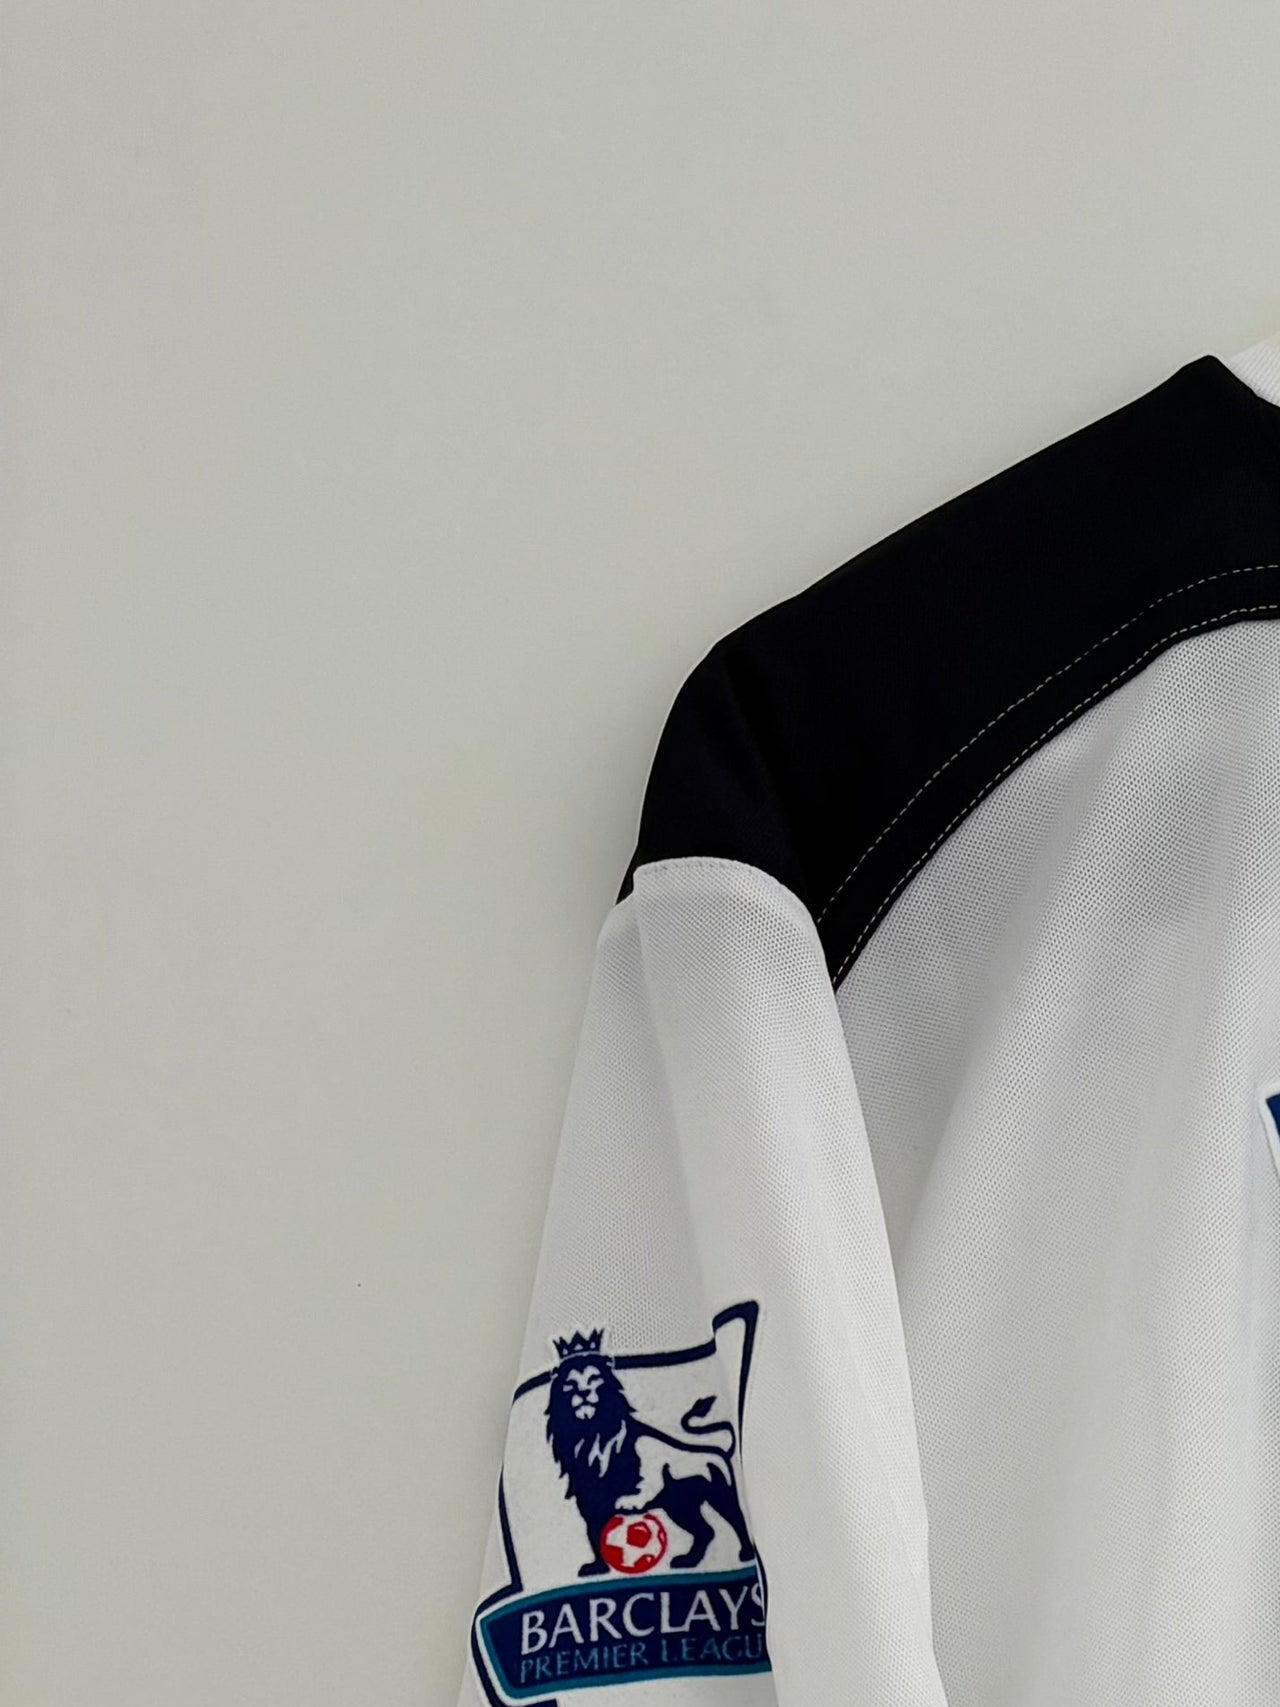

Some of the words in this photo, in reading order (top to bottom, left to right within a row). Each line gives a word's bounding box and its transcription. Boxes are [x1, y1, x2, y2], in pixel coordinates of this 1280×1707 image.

[521, 1582, 766, 1655] BARCLAYS
[520, 1641, 649, 1683] PREMIER
[661, 1633, 763, 1662] LEAGU
